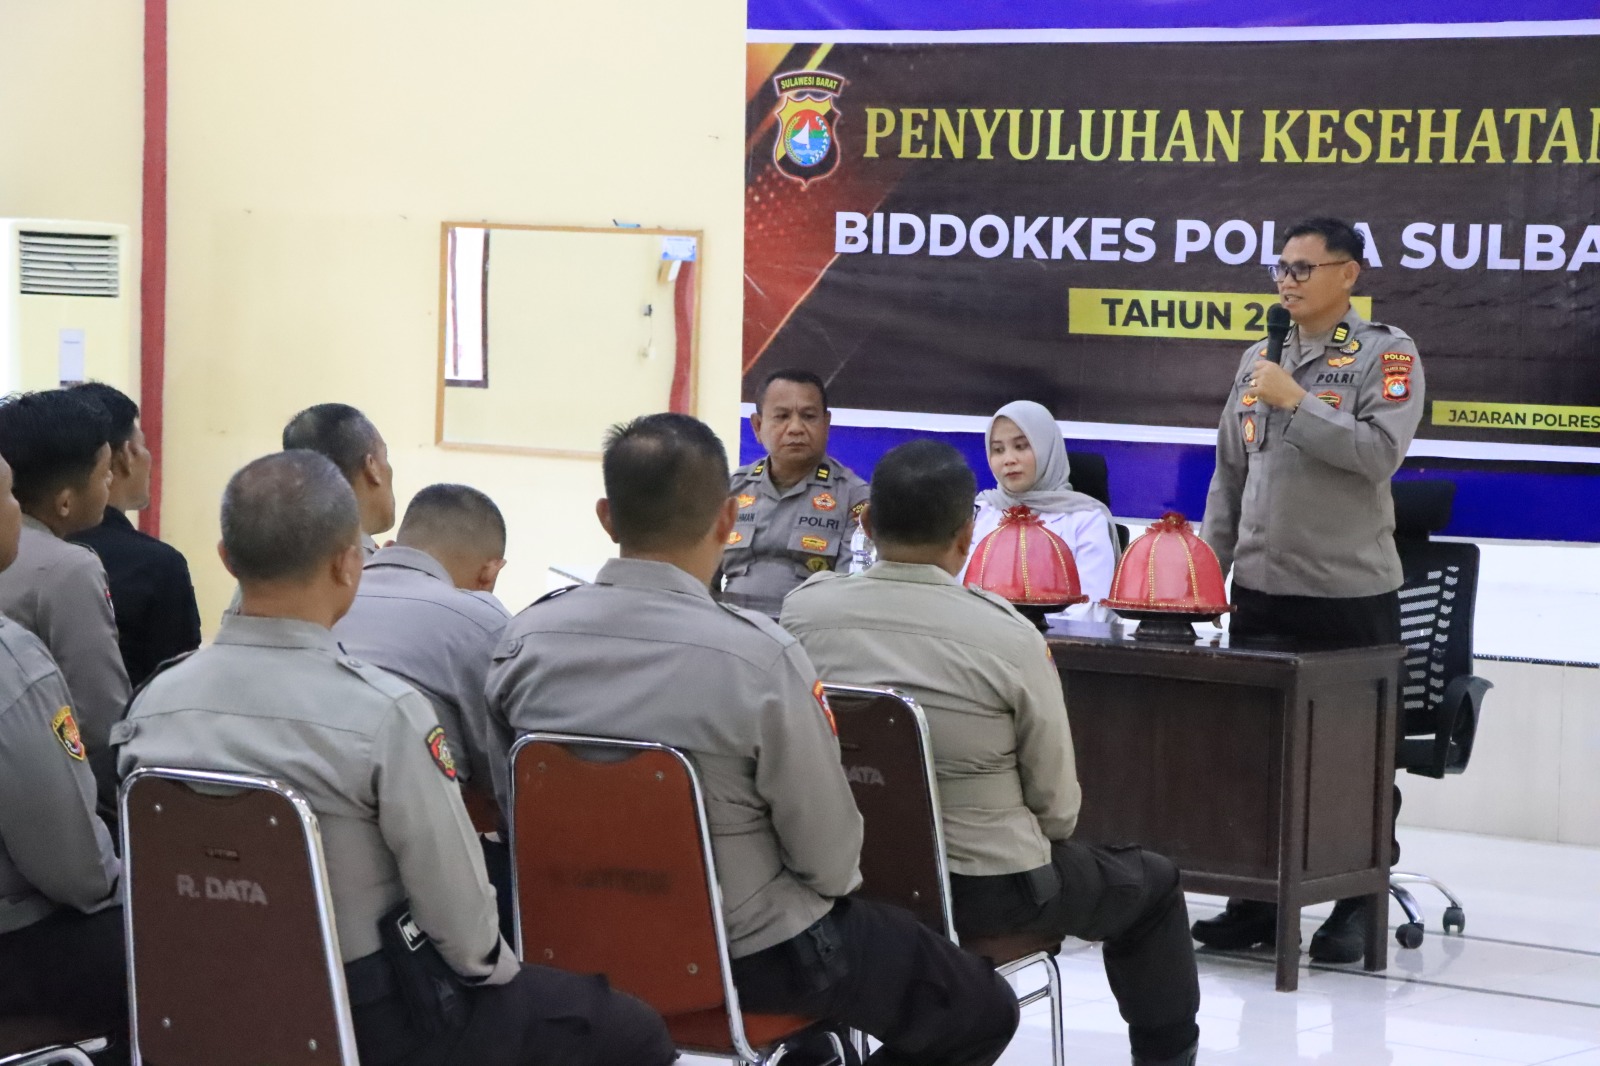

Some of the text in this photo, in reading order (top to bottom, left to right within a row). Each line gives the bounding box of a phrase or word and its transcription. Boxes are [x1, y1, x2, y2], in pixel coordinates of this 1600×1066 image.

[781, 77, 838, 89] SULAWESI BARAT
[863, 108, 1243, 162] PENYULUHAN
[835, 211, 1156, 262] BIDDOKKES
[1174, 219, 1383, 268] POLA
[1101, 297, 1232, 330] TAHUN
[1384, 354, 1411, 362] POLDA
[1316, 373, 1355, 384] POLRI
[1449, 410, 1600, 428] JAJARAN POLRES
[799, 516, 839, 530] POLRI
[177, 874, 268, 905] R. DATA
